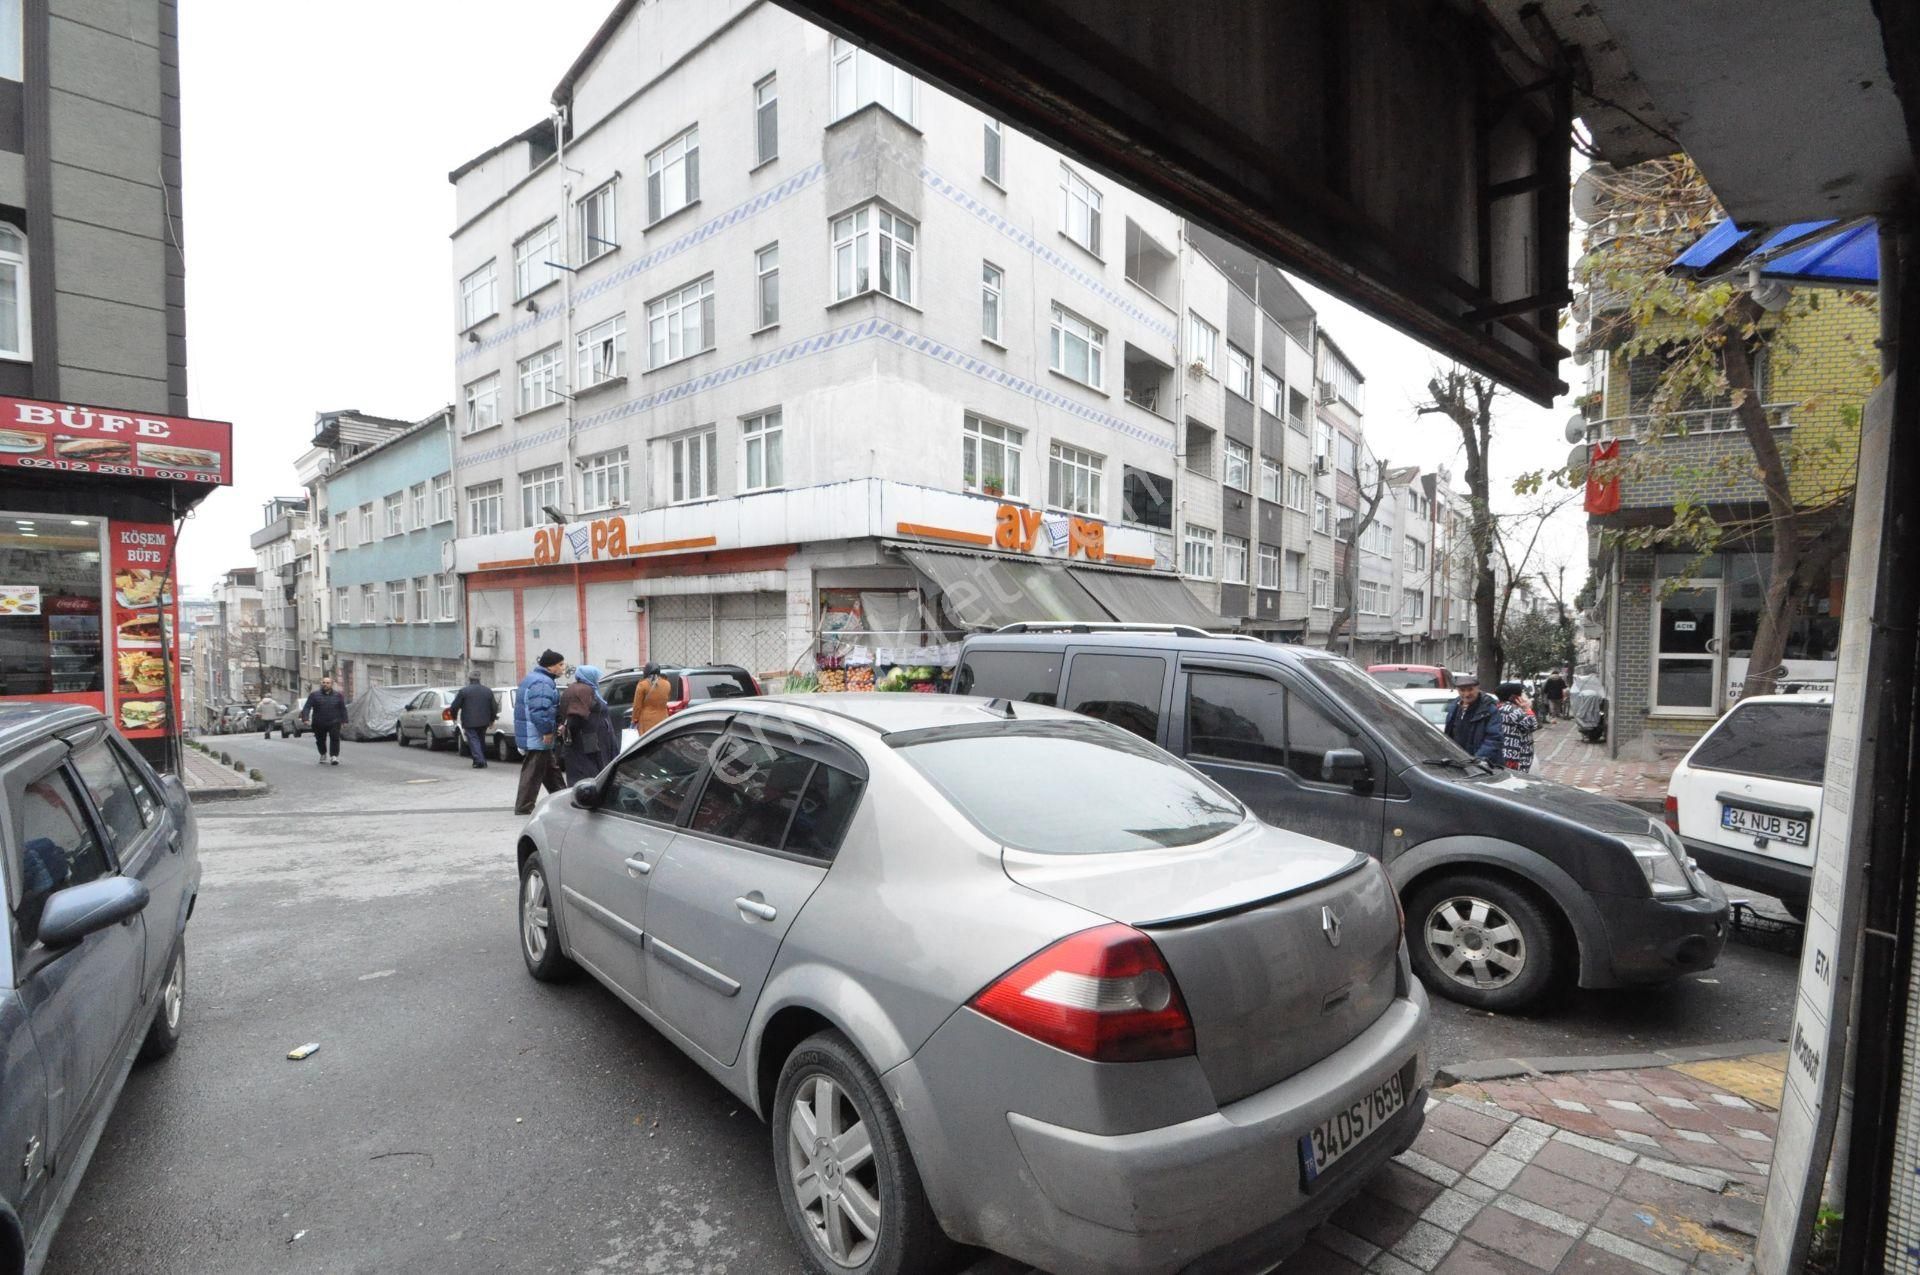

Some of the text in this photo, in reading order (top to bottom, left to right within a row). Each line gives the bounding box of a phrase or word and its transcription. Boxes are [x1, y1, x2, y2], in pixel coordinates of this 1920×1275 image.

[15, 403, 171, 438] BÜFE
[17, 457, 222, 483] 0212 581 00 81
[120, 530, 167, 547] KÖŞEM
[127, 548, 161, 563] BÜFE
[1731, 810, 1745, 825] 34
[1751, 813, 1781, 833] NUB
[1786, 821, 1805, 839] 52
